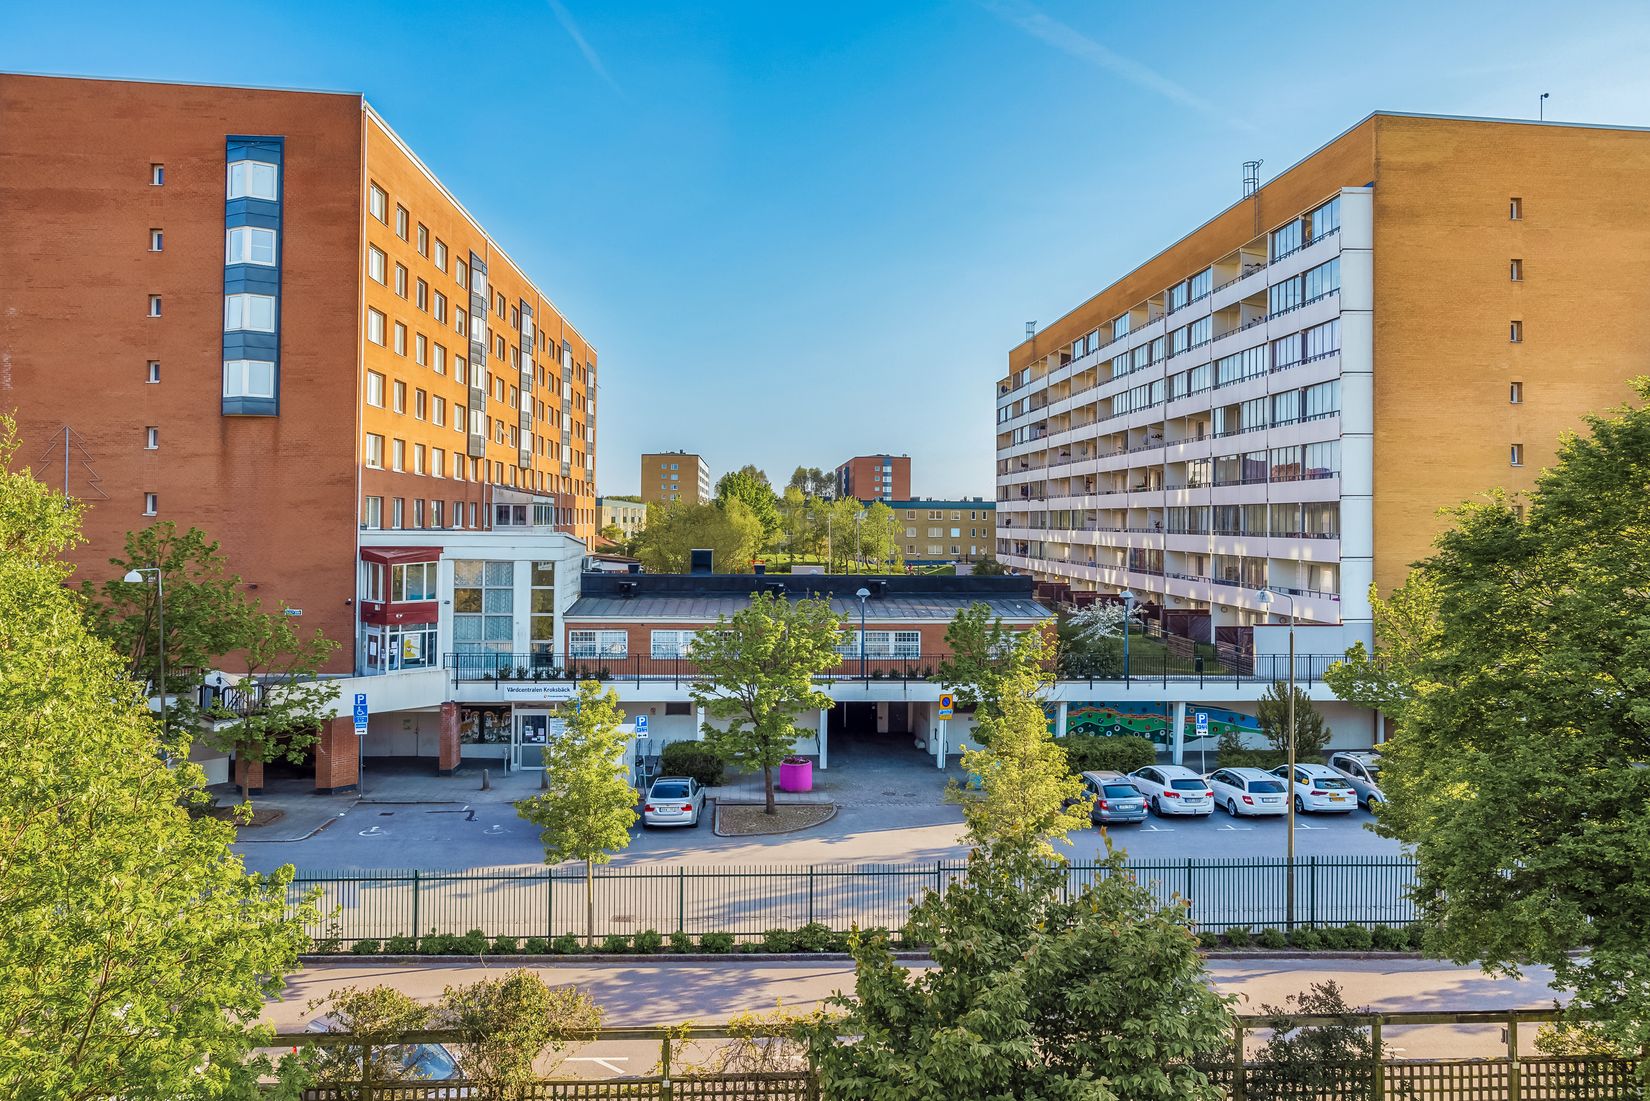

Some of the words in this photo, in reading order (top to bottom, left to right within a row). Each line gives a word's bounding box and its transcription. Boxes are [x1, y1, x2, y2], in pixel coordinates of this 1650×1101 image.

[357, 694, 365, 704] P
[638, 717, 646, 726] P
[1198, 714, 1206, 724] P
